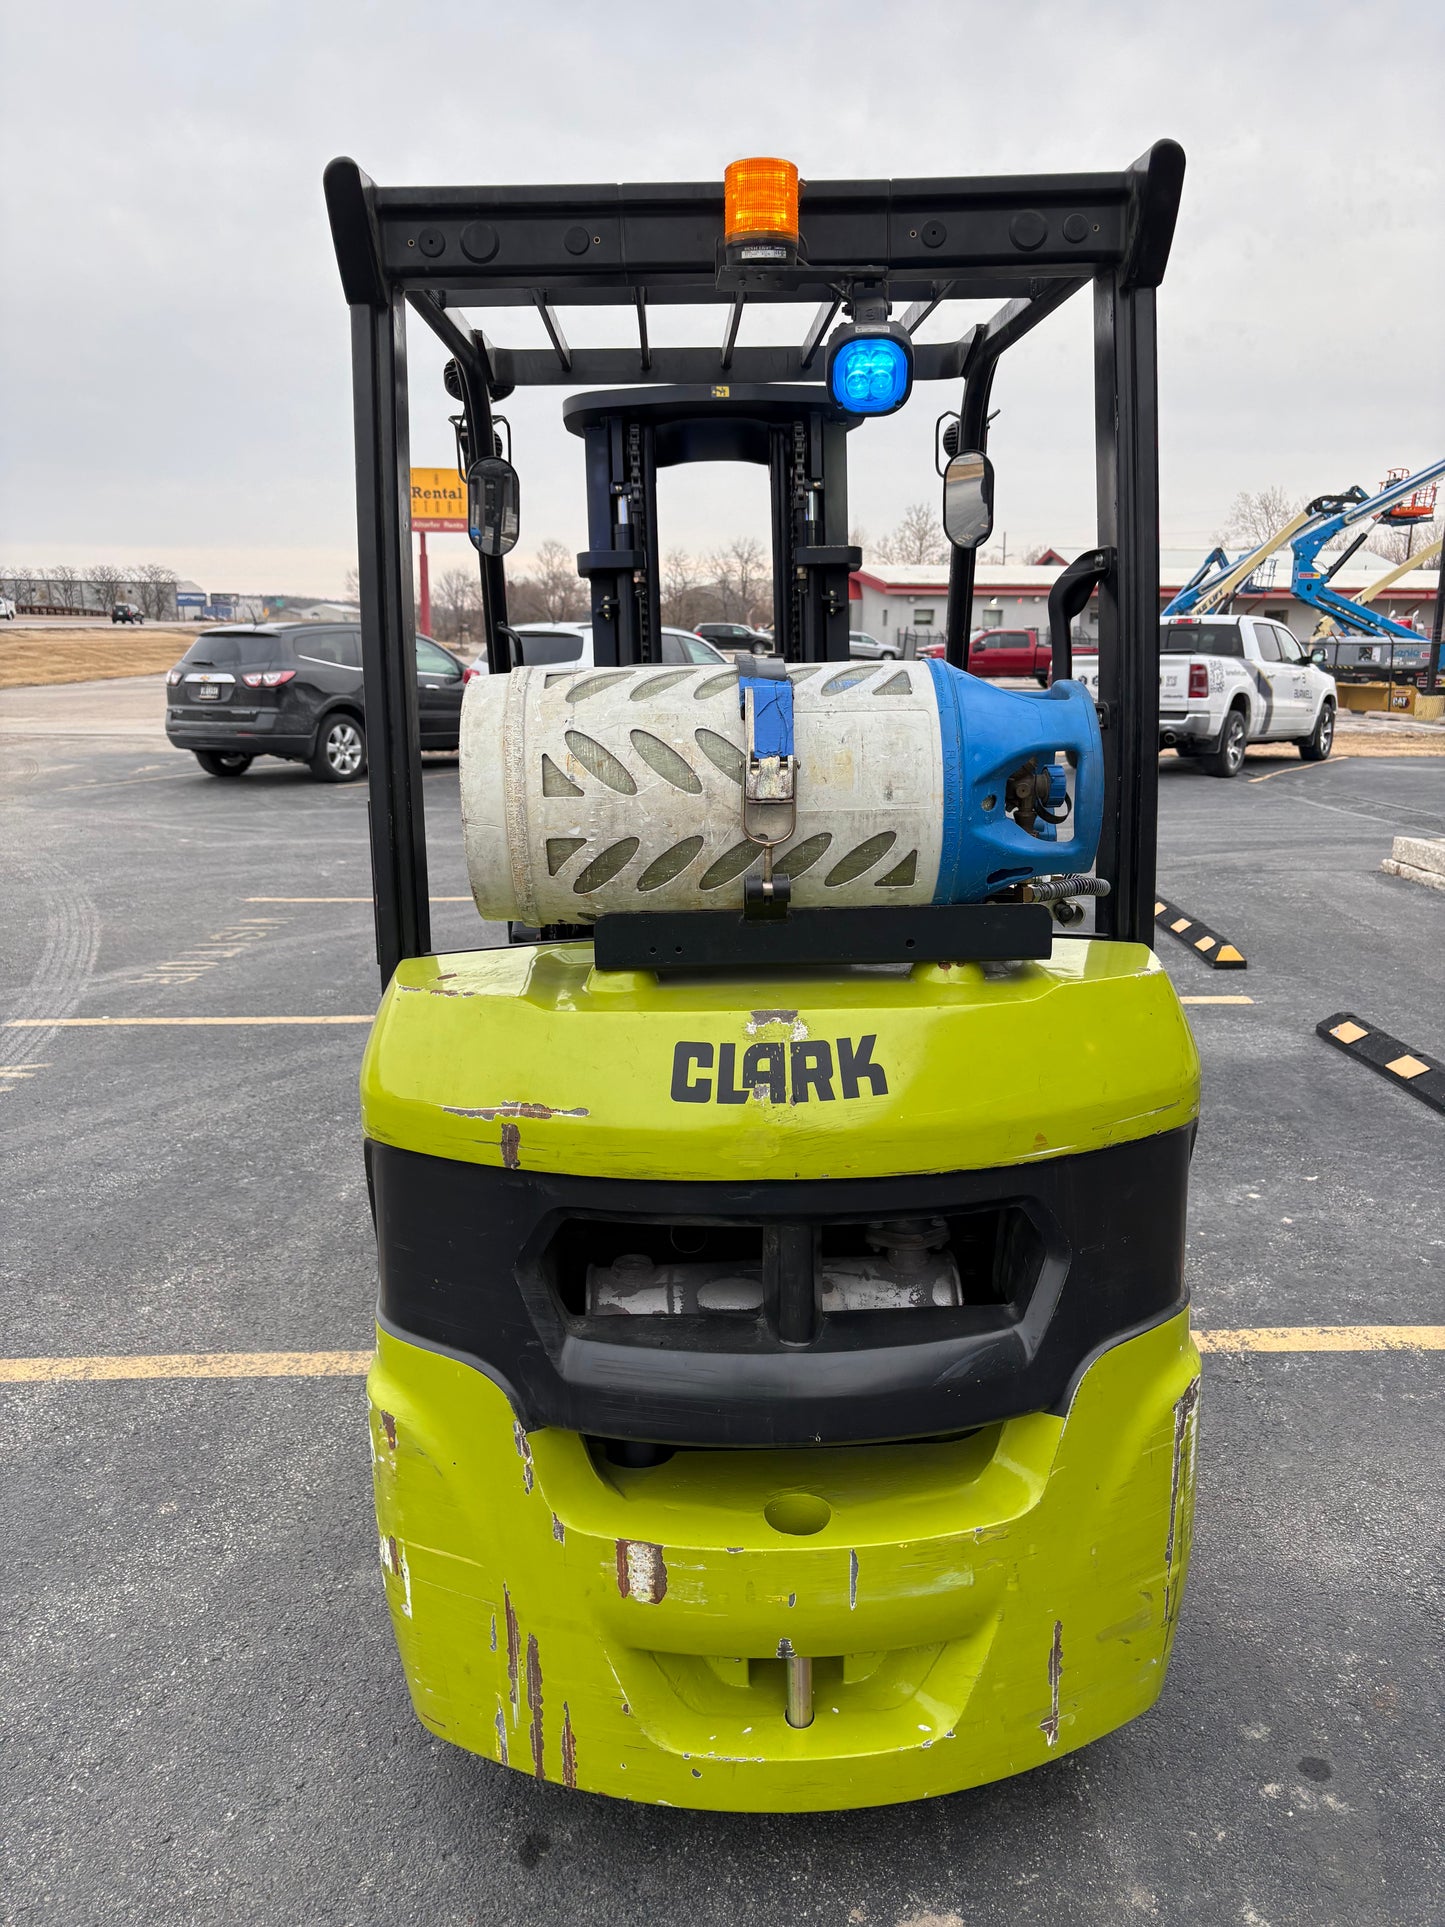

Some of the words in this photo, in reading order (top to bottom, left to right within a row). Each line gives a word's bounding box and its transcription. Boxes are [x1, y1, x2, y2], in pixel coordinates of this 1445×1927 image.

[411, 487, 463, 499] Rental
[1392, 697, 1408, 707] CAT
[670, 1034, 889, 1105] CLARK
